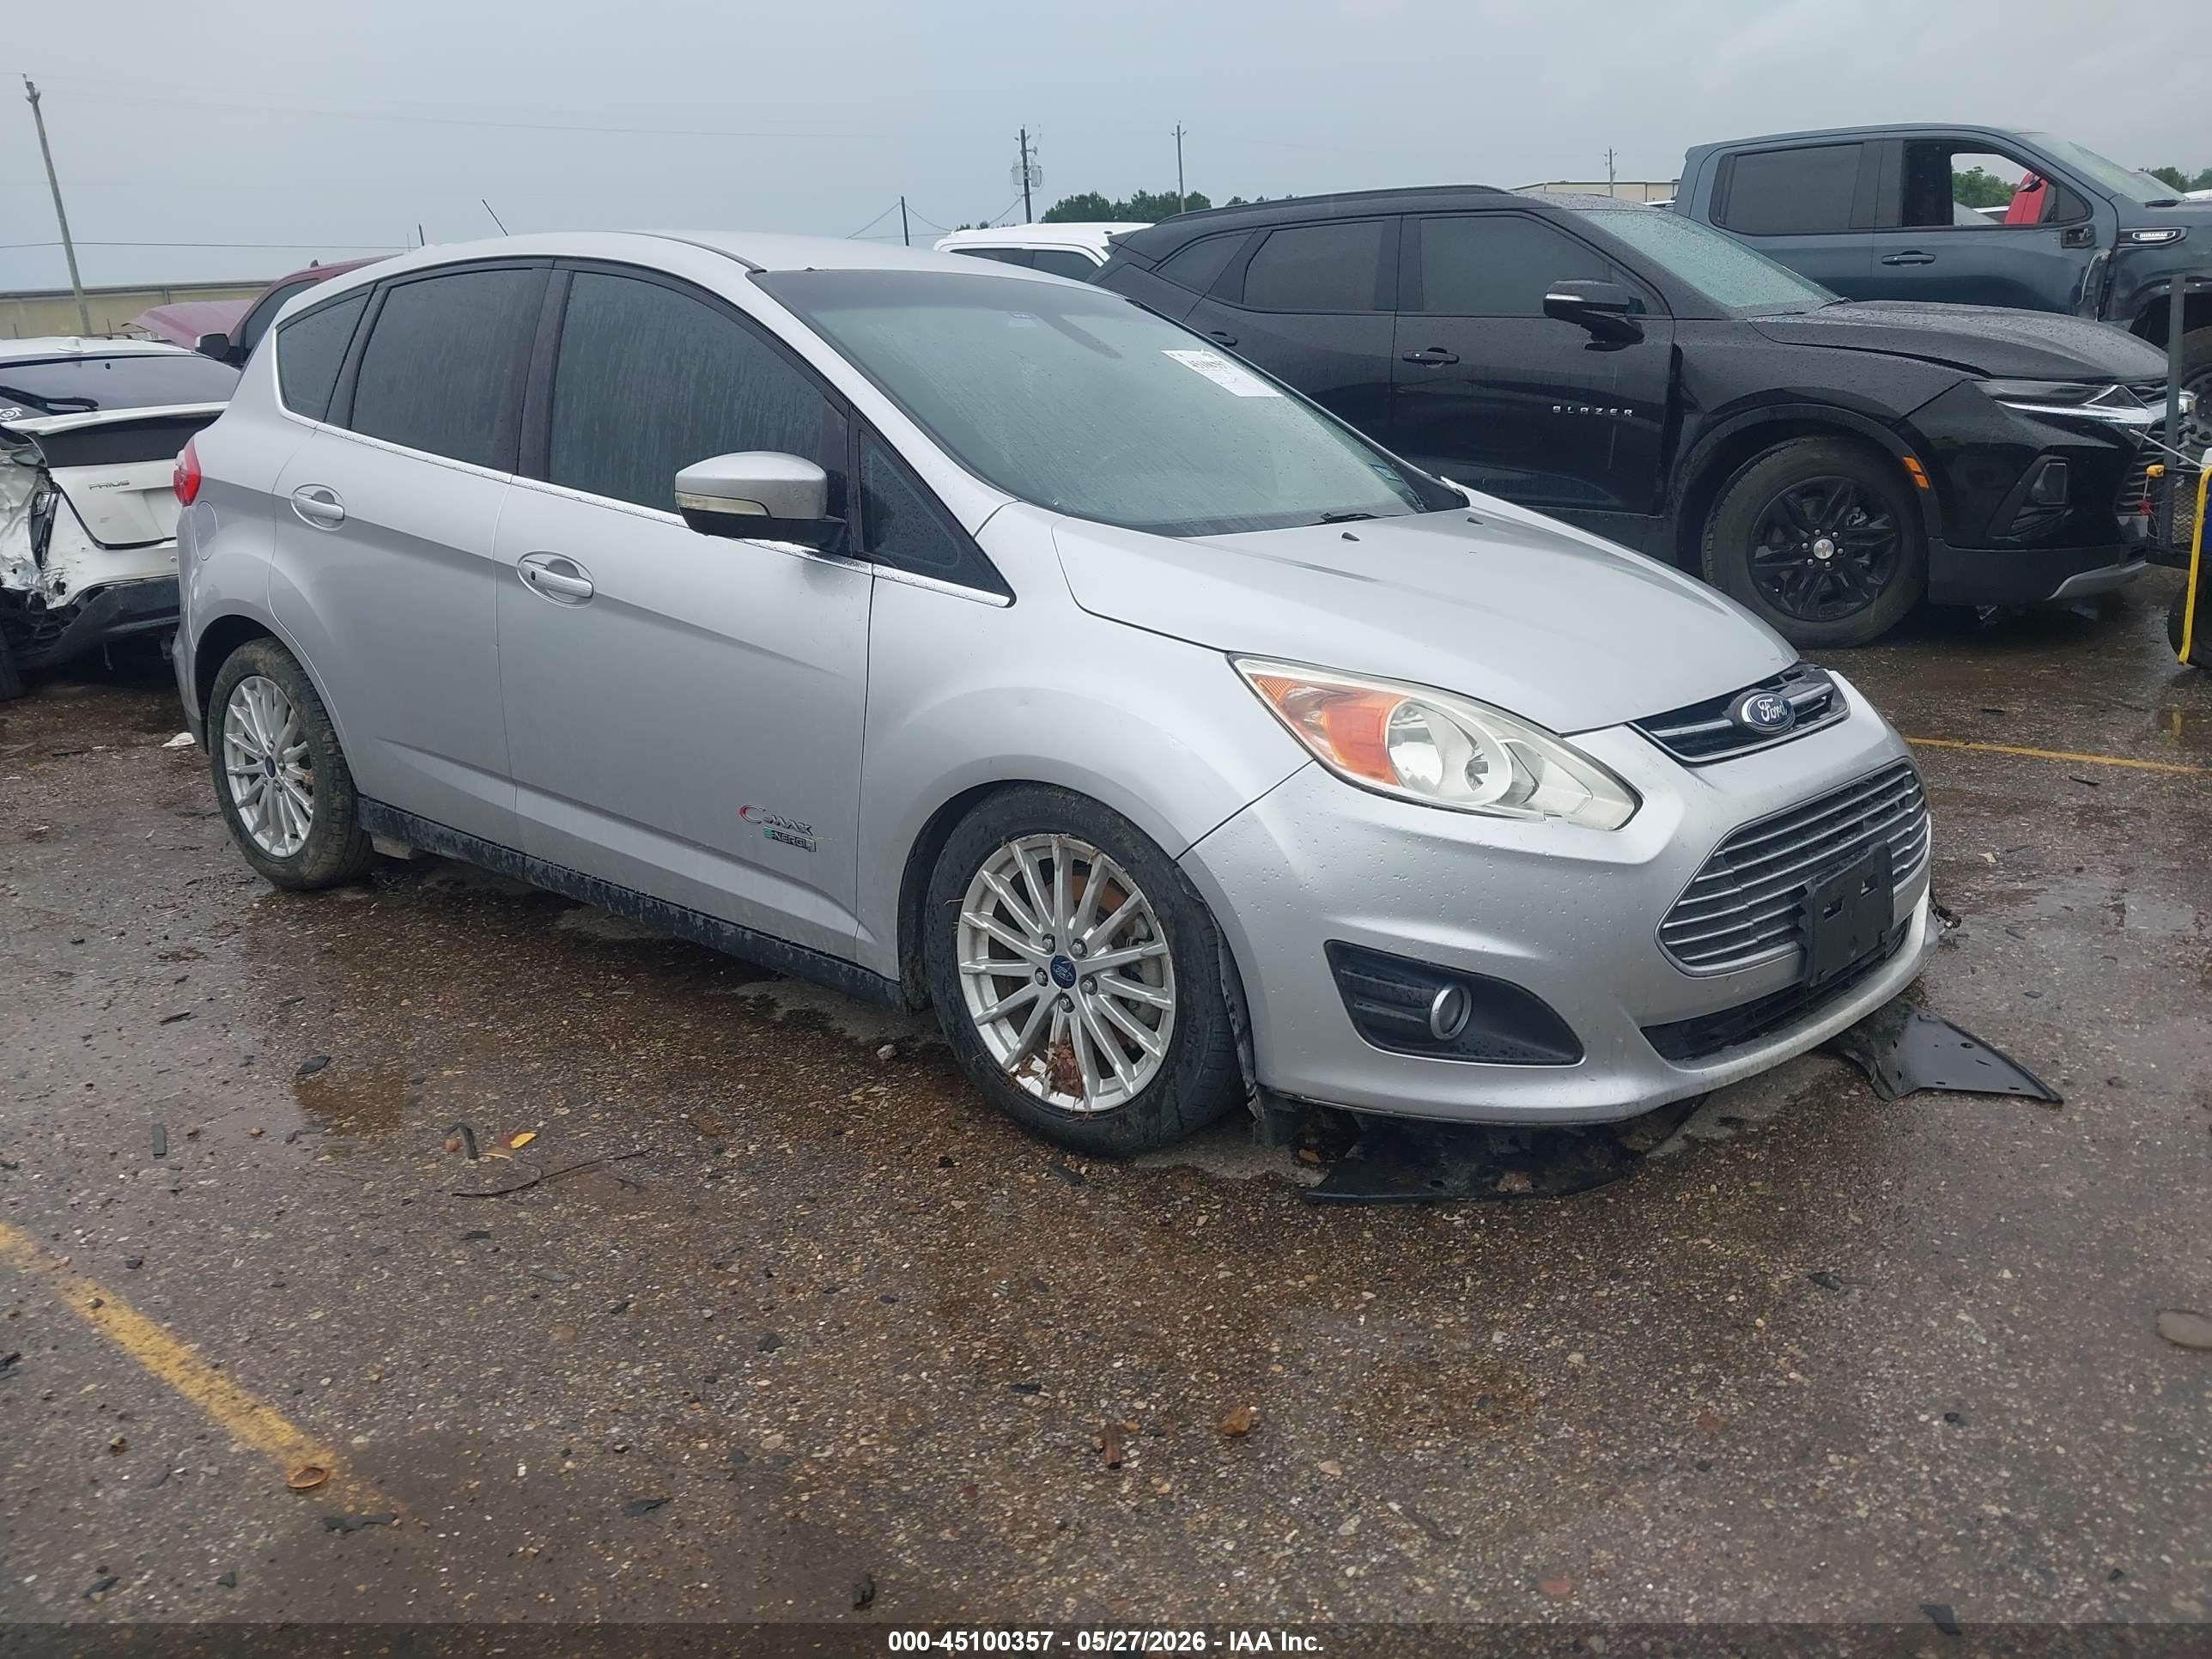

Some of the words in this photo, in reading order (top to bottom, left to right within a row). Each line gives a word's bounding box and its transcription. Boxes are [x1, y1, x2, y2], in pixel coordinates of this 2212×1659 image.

[1553, 405, 1632, 417] BLAZER
[88, 480, 130, 490] PRIUS
[1757, 697, 1788, 722] Ford
